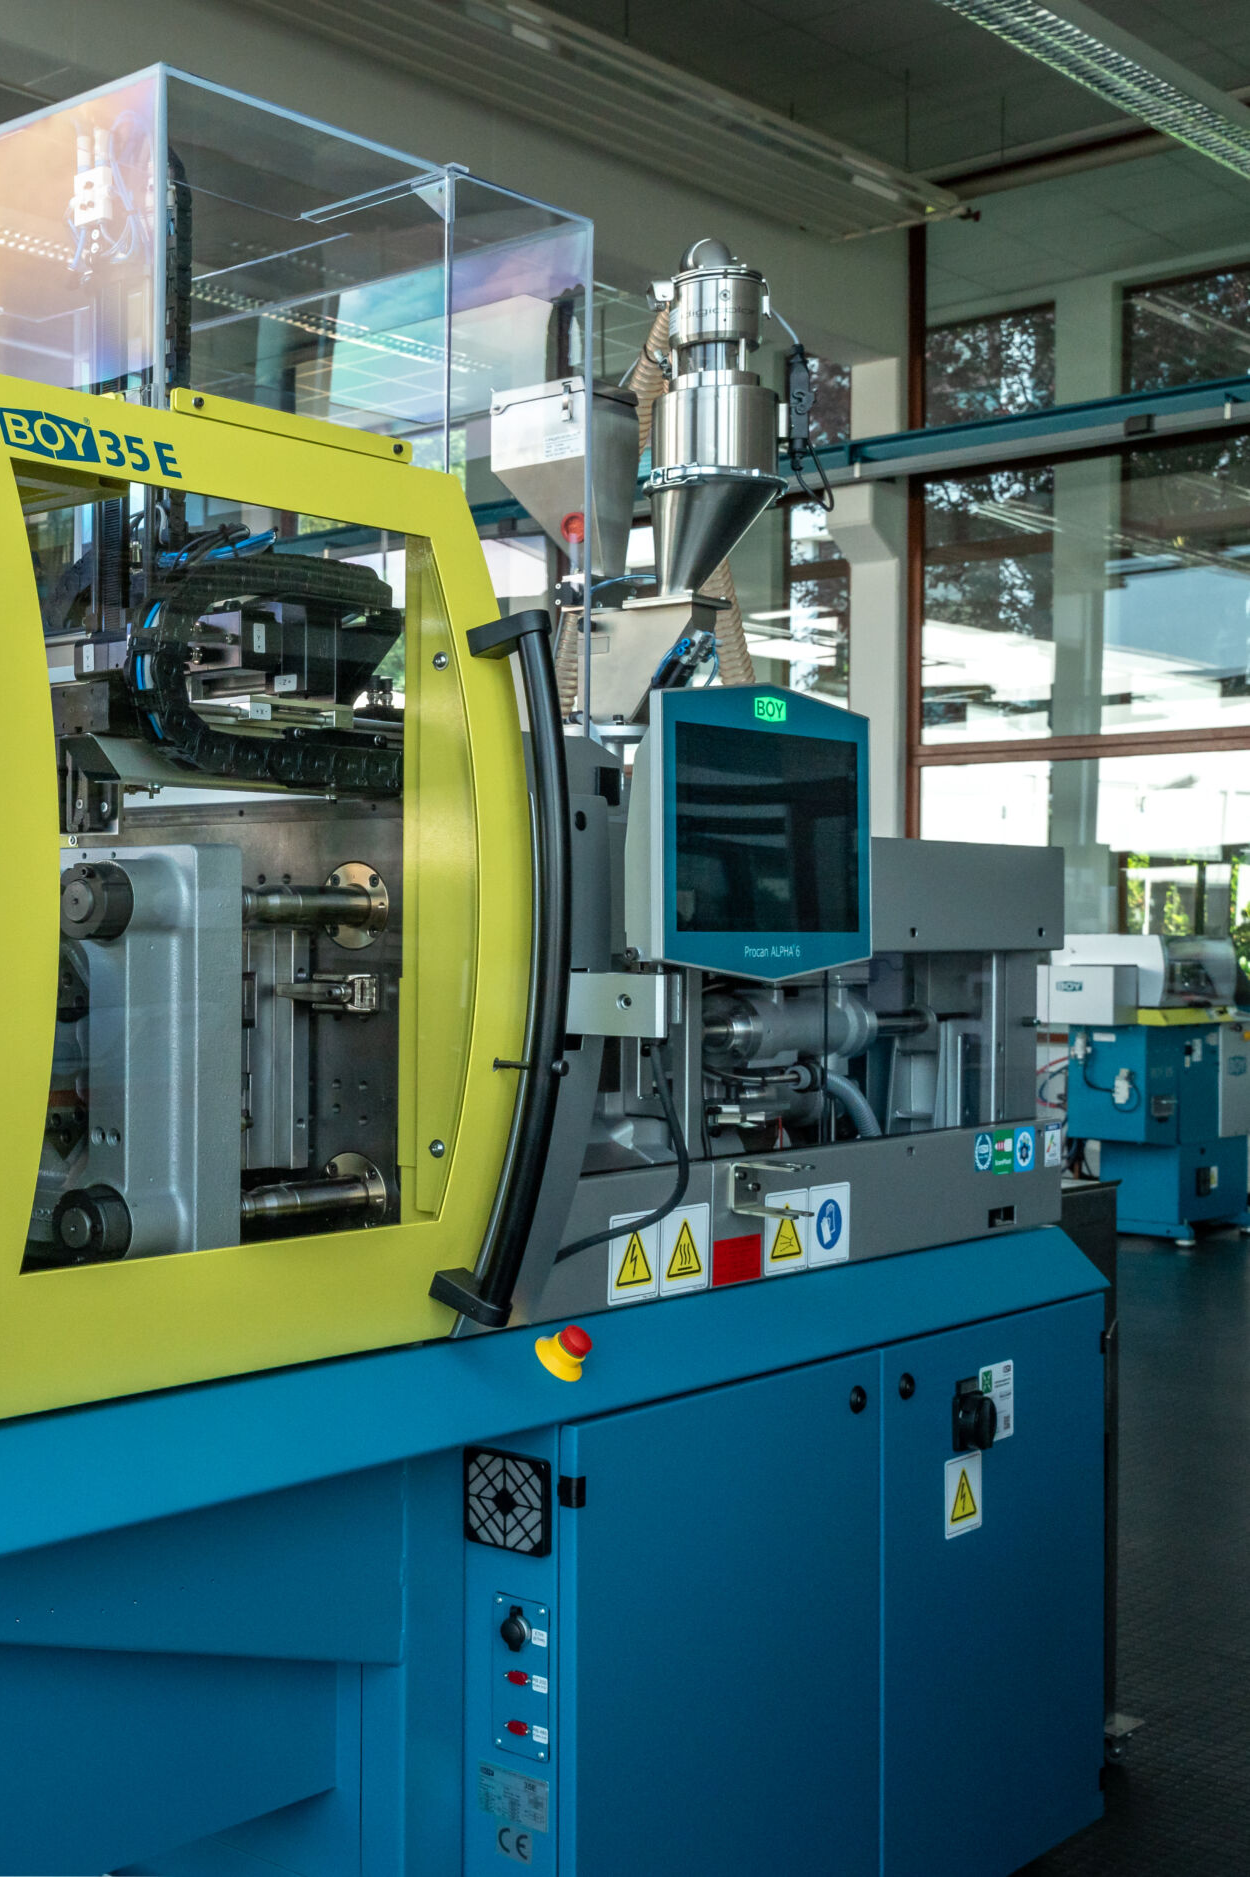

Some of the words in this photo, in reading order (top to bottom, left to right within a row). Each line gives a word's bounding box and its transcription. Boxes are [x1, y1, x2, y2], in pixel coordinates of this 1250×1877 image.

[1, 410, 88, 458] BOY
[756, 699, 785, 719] BOY
[743, 945, 769, 958] Procan
[1056, 981, 1083, 992] BOY
